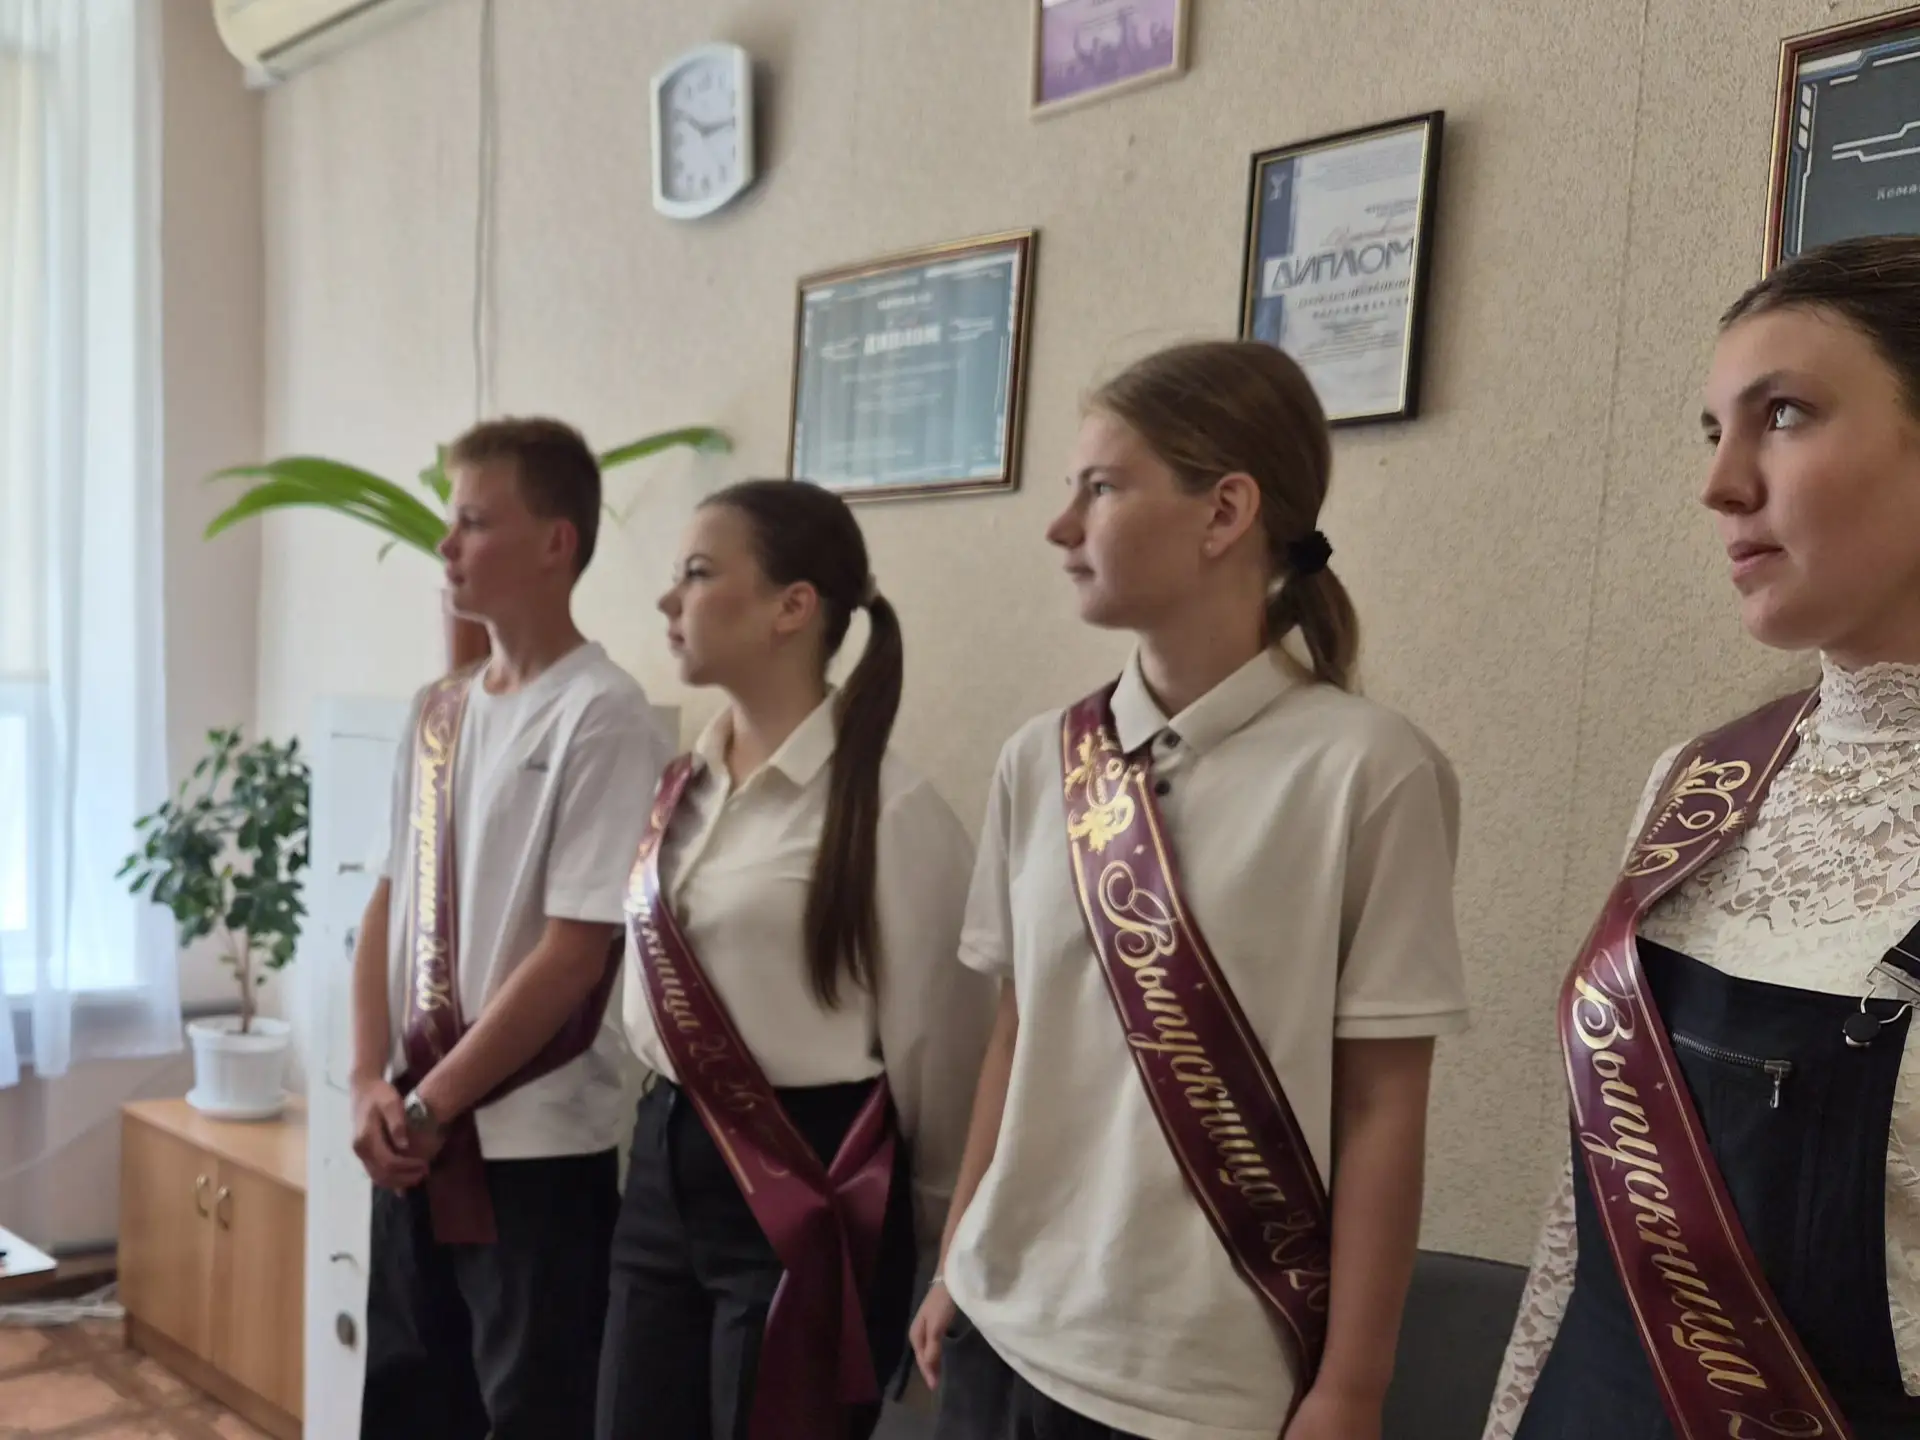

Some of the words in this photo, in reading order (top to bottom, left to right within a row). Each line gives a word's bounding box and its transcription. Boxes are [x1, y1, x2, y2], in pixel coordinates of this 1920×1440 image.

[1271, 237, 1415, 290] ДИПЛОМ
[622, 808, 702, 1033] ускница
[1099, 860, 1287, 1209] Выпускница
[1571, 948, 1769, 1398] Выпускница
